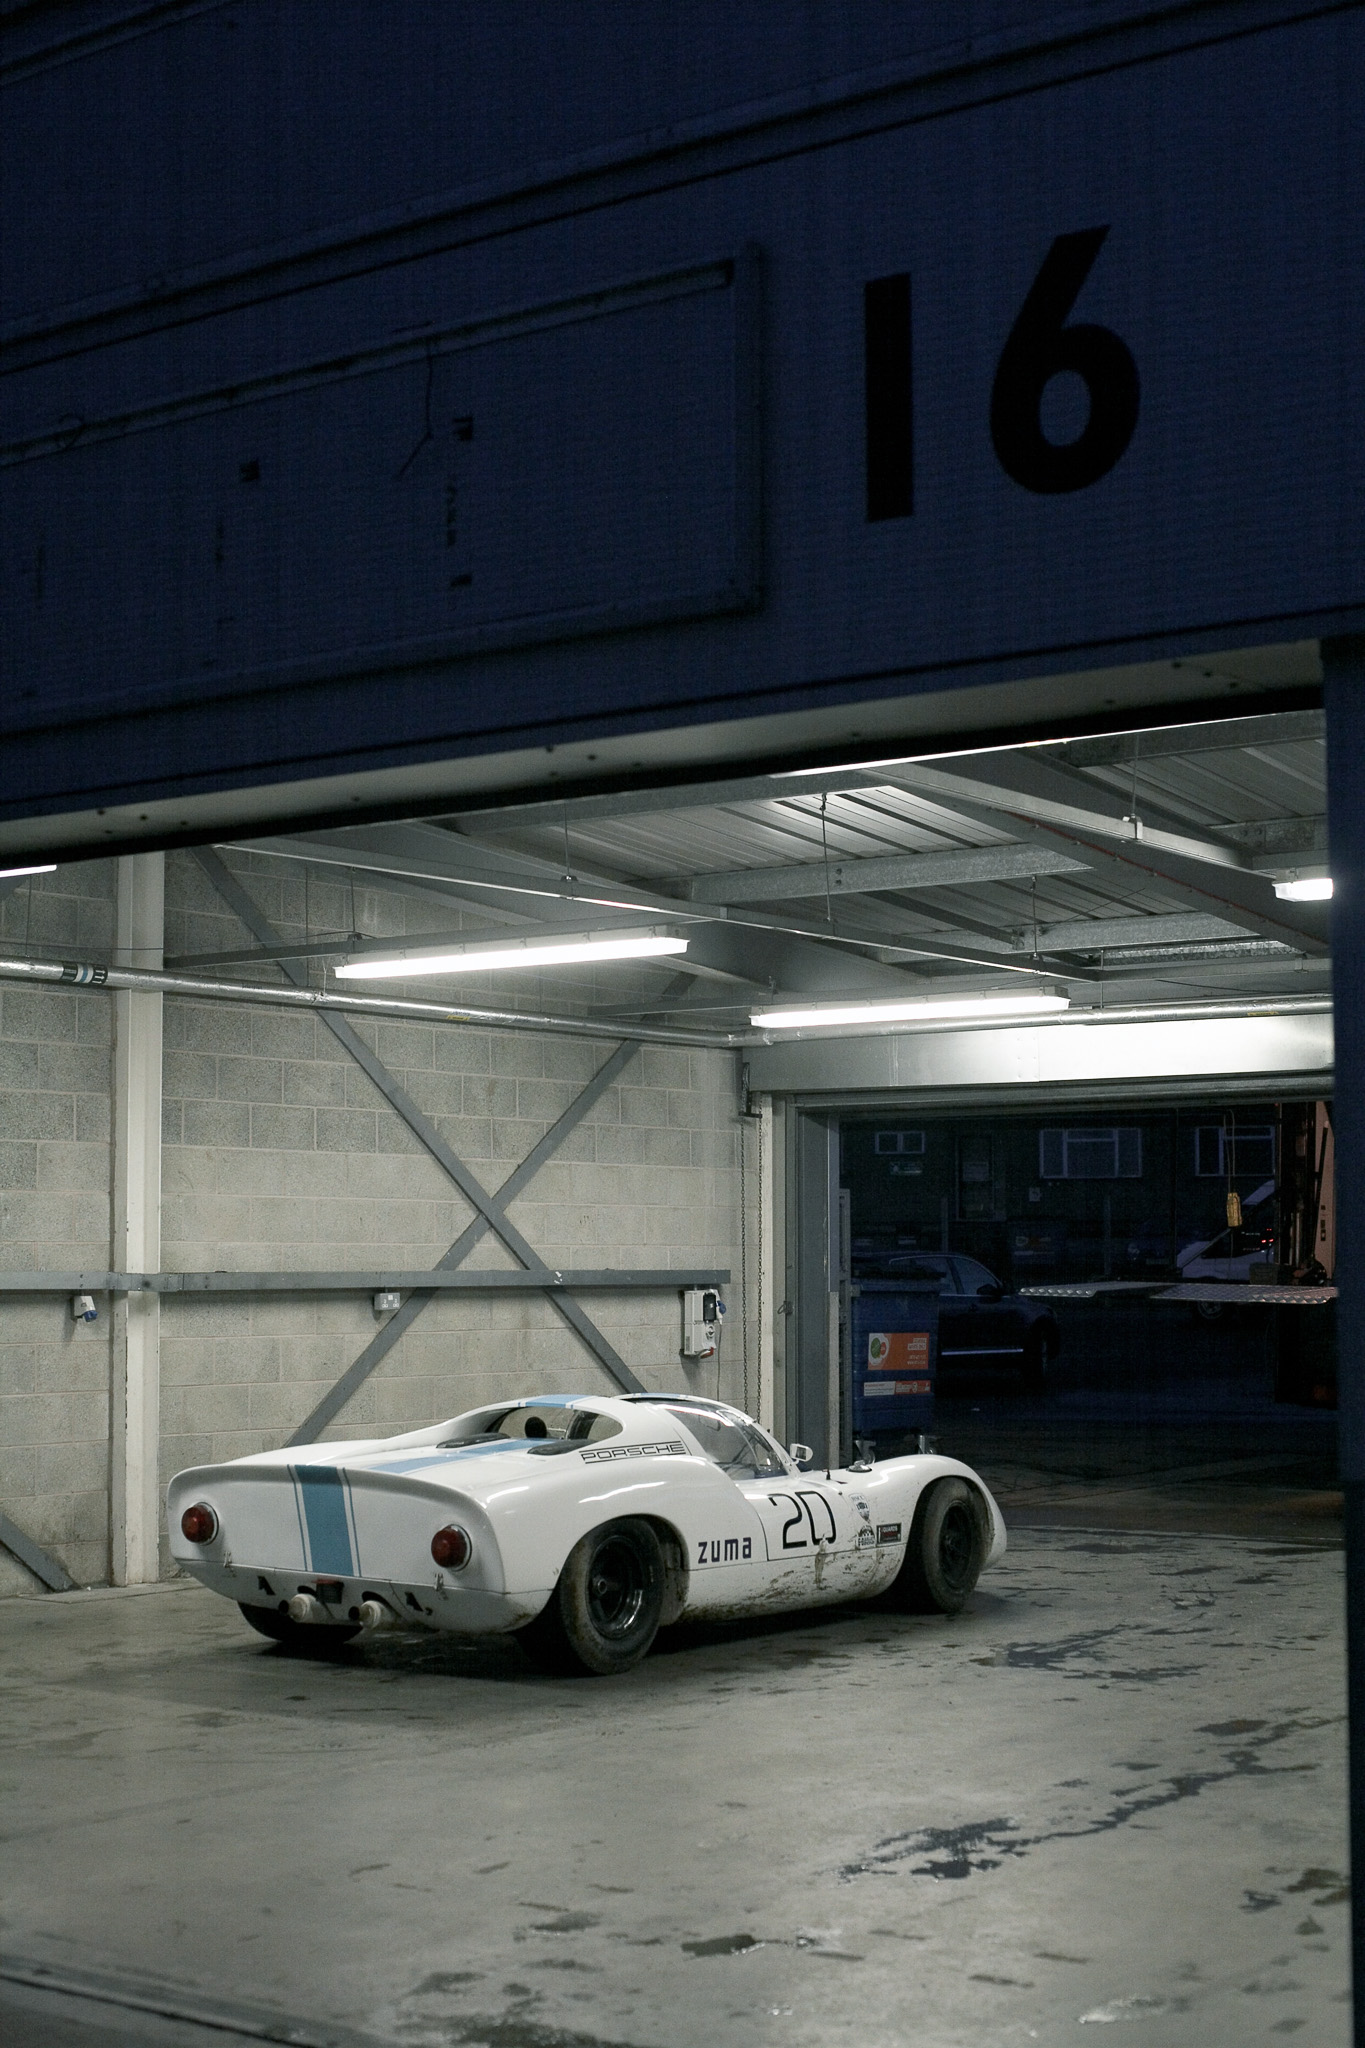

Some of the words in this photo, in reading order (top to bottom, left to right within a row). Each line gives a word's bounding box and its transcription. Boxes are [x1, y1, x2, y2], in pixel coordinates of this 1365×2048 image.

[865, 224, 1141, 523] 16
[580, 1443, 686, 1461] PORSCHE
[767, 1490, 836, 1549] 20
[698, 1536, 752, 1564] zuma
